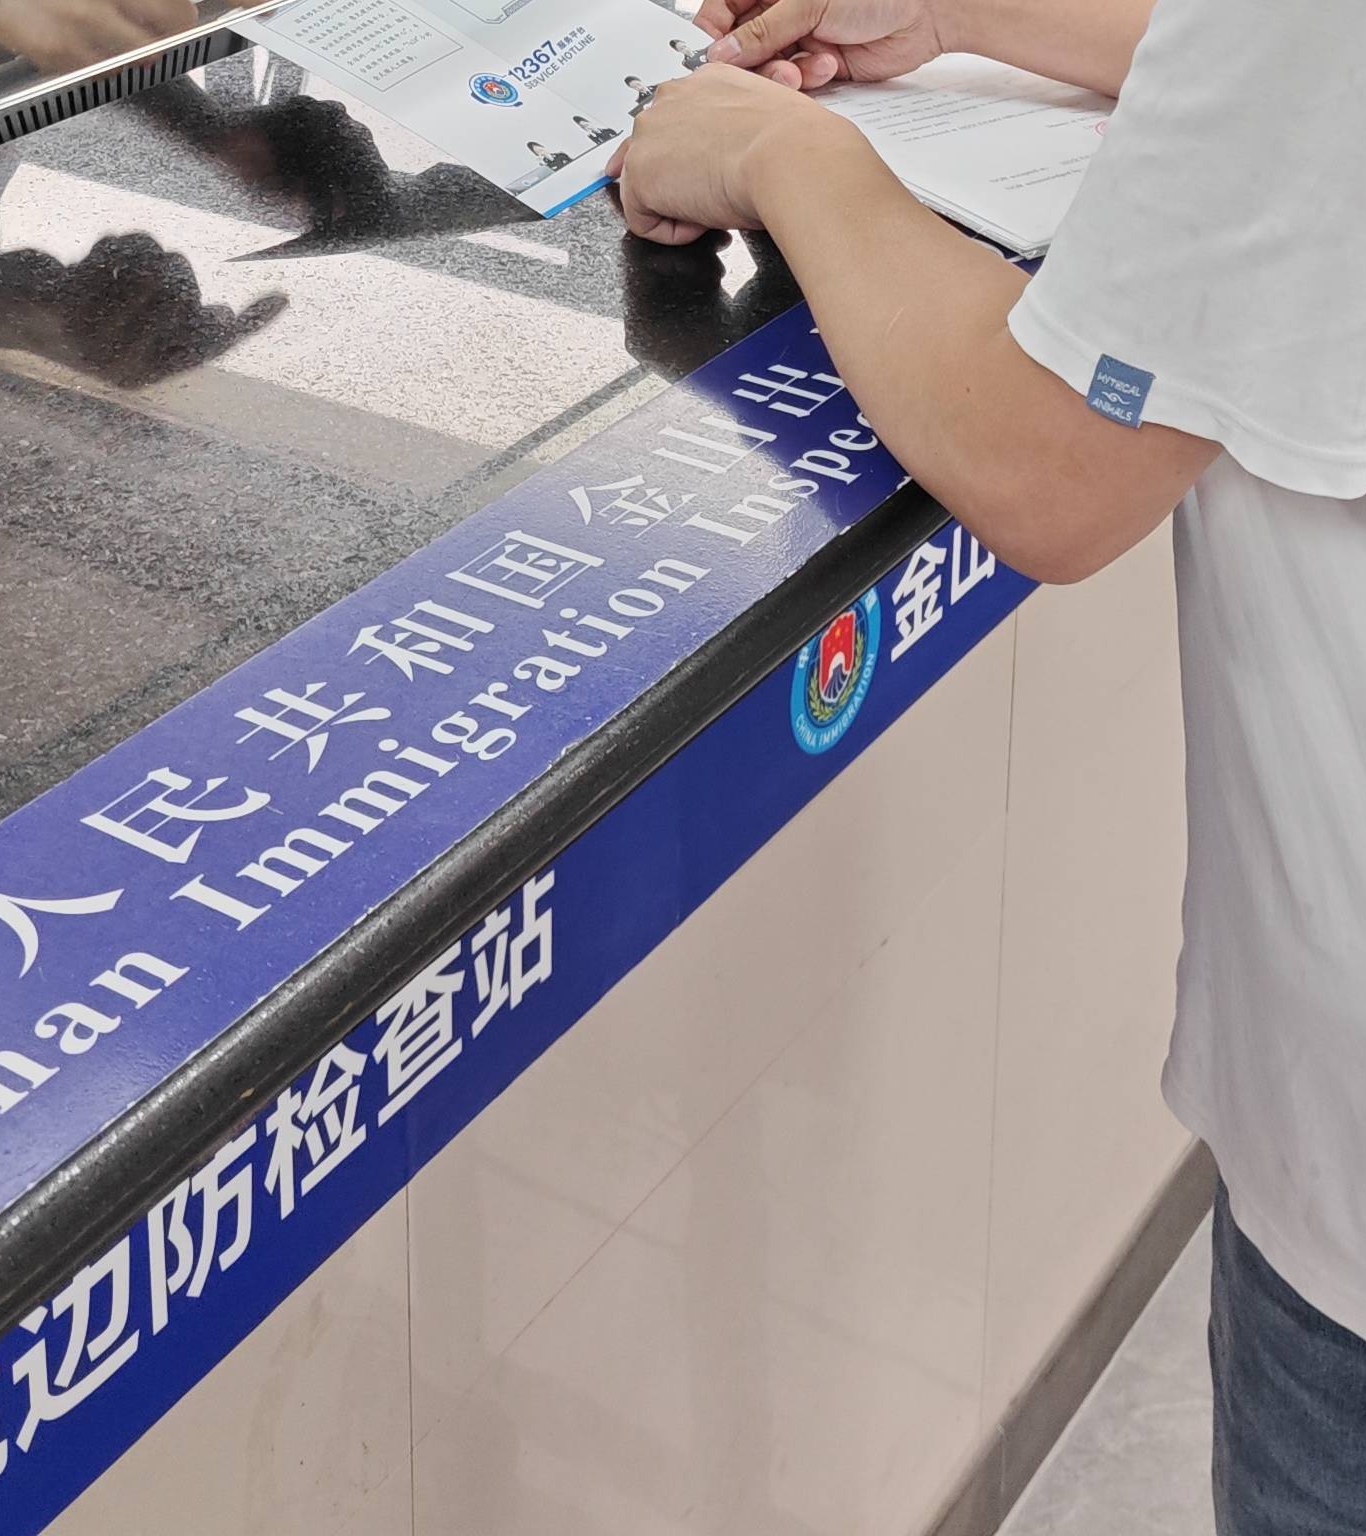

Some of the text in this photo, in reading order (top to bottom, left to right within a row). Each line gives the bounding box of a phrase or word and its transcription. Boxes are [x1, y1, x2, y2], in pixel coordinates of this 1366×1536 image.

[508, 40, 558, 82] 12367
[558, 33, 596, 65] HOTLINE
[1091, 397, 1133, 421] ANIMALS
[891, 525, 995, 663] 金山
[169, 552, 711, 931] Immigration
[681, 413, 878, 547] Inspe
[795, 653, 875, 747] CHINA IMMIGRATION
